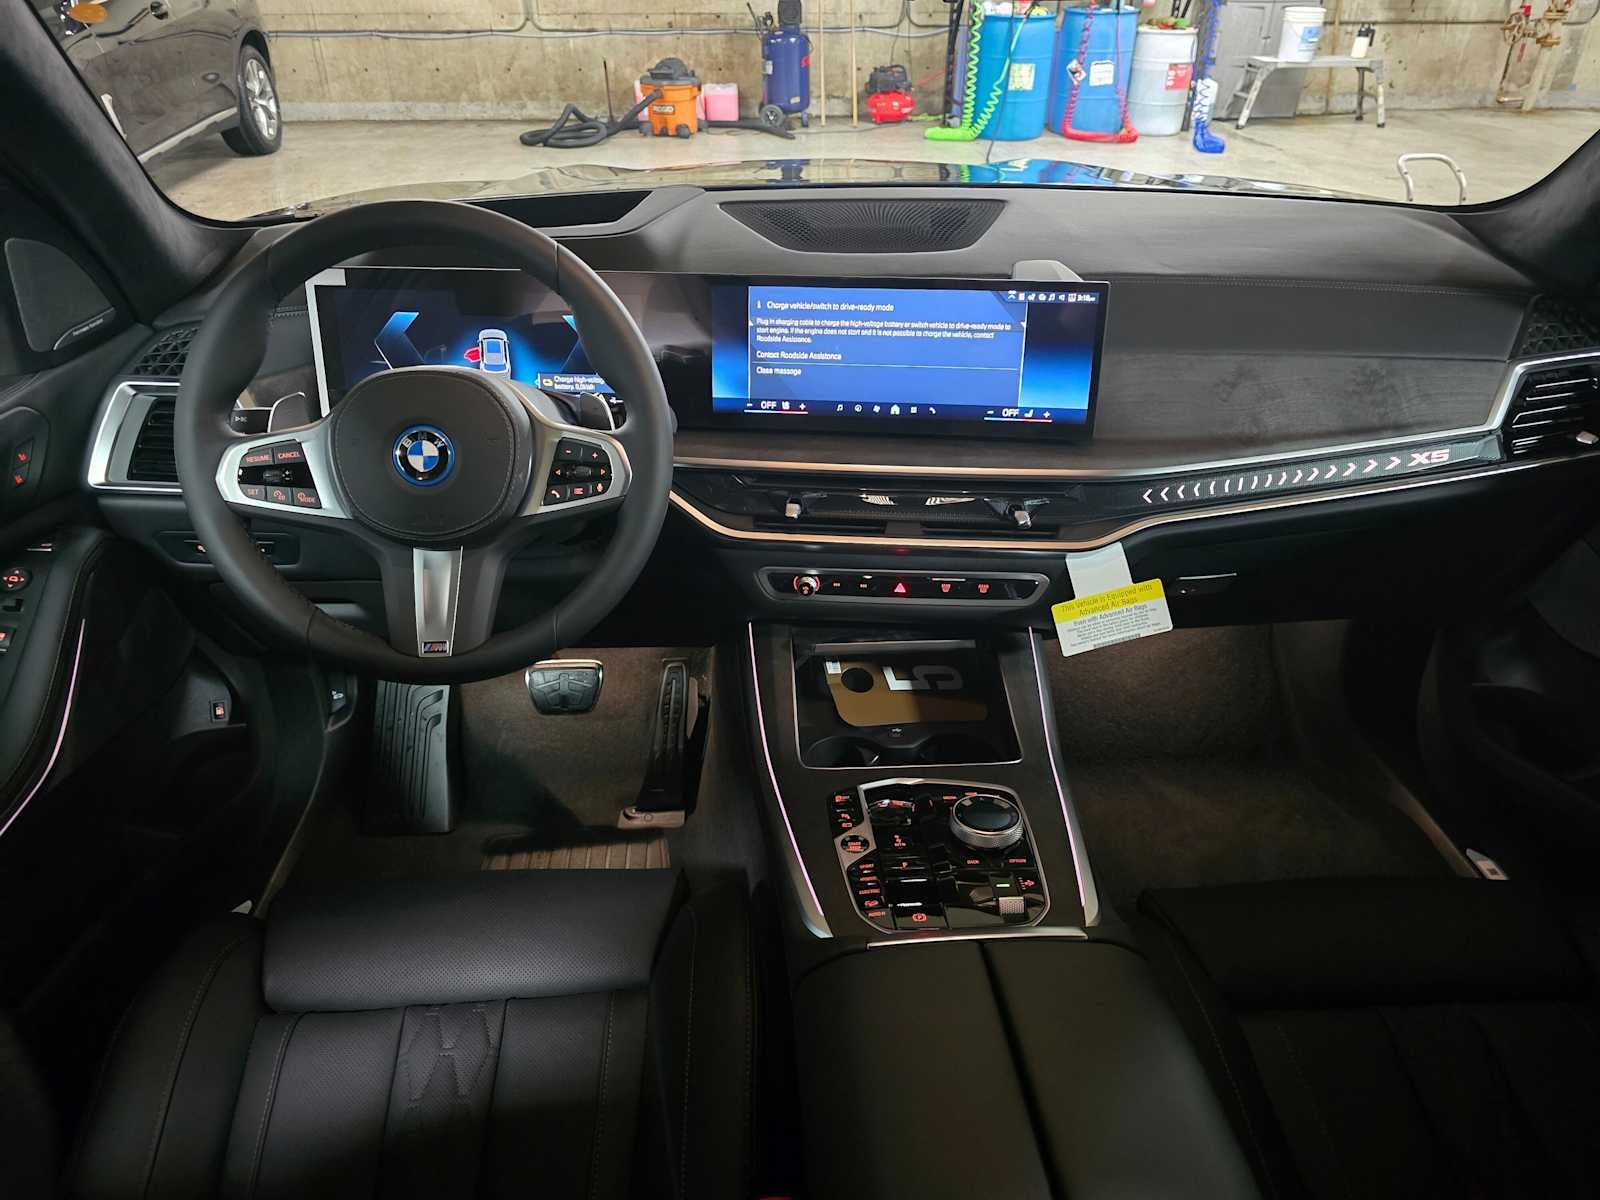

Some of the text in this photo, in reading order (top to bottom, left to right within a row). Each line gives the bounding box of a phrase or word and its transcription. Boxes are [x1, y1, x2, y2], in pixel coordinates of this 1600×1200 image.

[767, 301, 790, 310] Charge
[840, 303, 875, 312] drive-ready
[875, 304, 894, 312] mode
[756, 318, 768, 326] Plug
[756, 351, 842, 360] Contact Roadside Assistance
[756, 366, 802, 376] Close message
[760, 400, 777, 410] OFF
[1002, 408, 1019, 418] OFF
[278, 451, 300, 459] CANCEL
[1408, 448, 1450, 466] X5
[247, 488, 258, 496] SET
[1061, 604, 1074, 613] This
[1139, 584, 1153, 593] with
[1079, 603, 1110, 616] Advanced
[1111, 601, 1120, 609] Air
